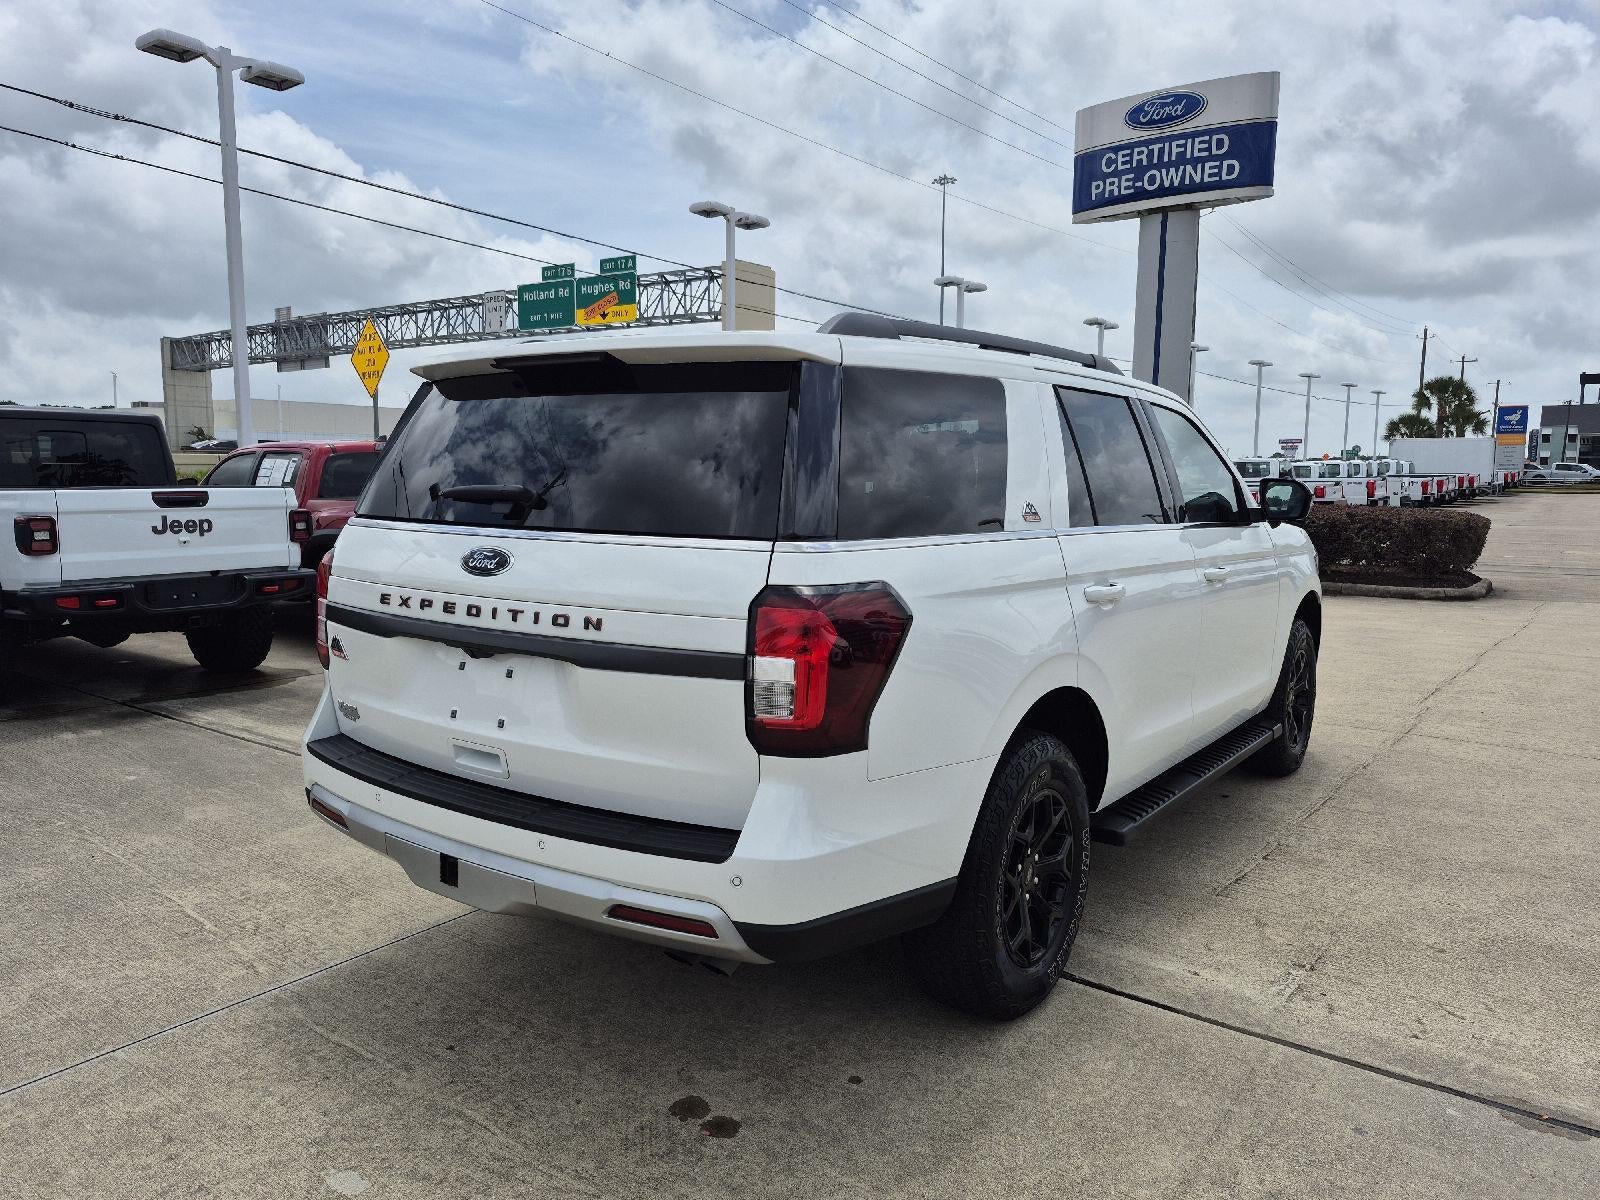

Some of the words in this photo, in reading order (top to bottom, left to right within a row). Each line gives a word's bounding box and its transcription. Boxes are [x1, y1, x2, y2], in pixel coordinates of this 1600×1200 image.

[1139, 96, 1187, 123] Ford
[1101, 133, 1230, 173] CERTIFIED
[1091, 159, 1240, 200] PRE-OWNED
[544, 269, 556, 277] EXIT
[603, 262, 615, 270] EXIT
[523, 288, 555, 301] Holland
[558, 287, 570, 297] Rd
[581, 282, 615, 295] Hughes
[619, 279, 631, 290] Rd
[530, 314, 541, 322] EXIT
[612, 309, 628, 318] ONLY
[151, 515, 213, 537] Jeep
[468, 549, 498, 569] Ford
[379, 593, 603, 631] EXPEDITION
